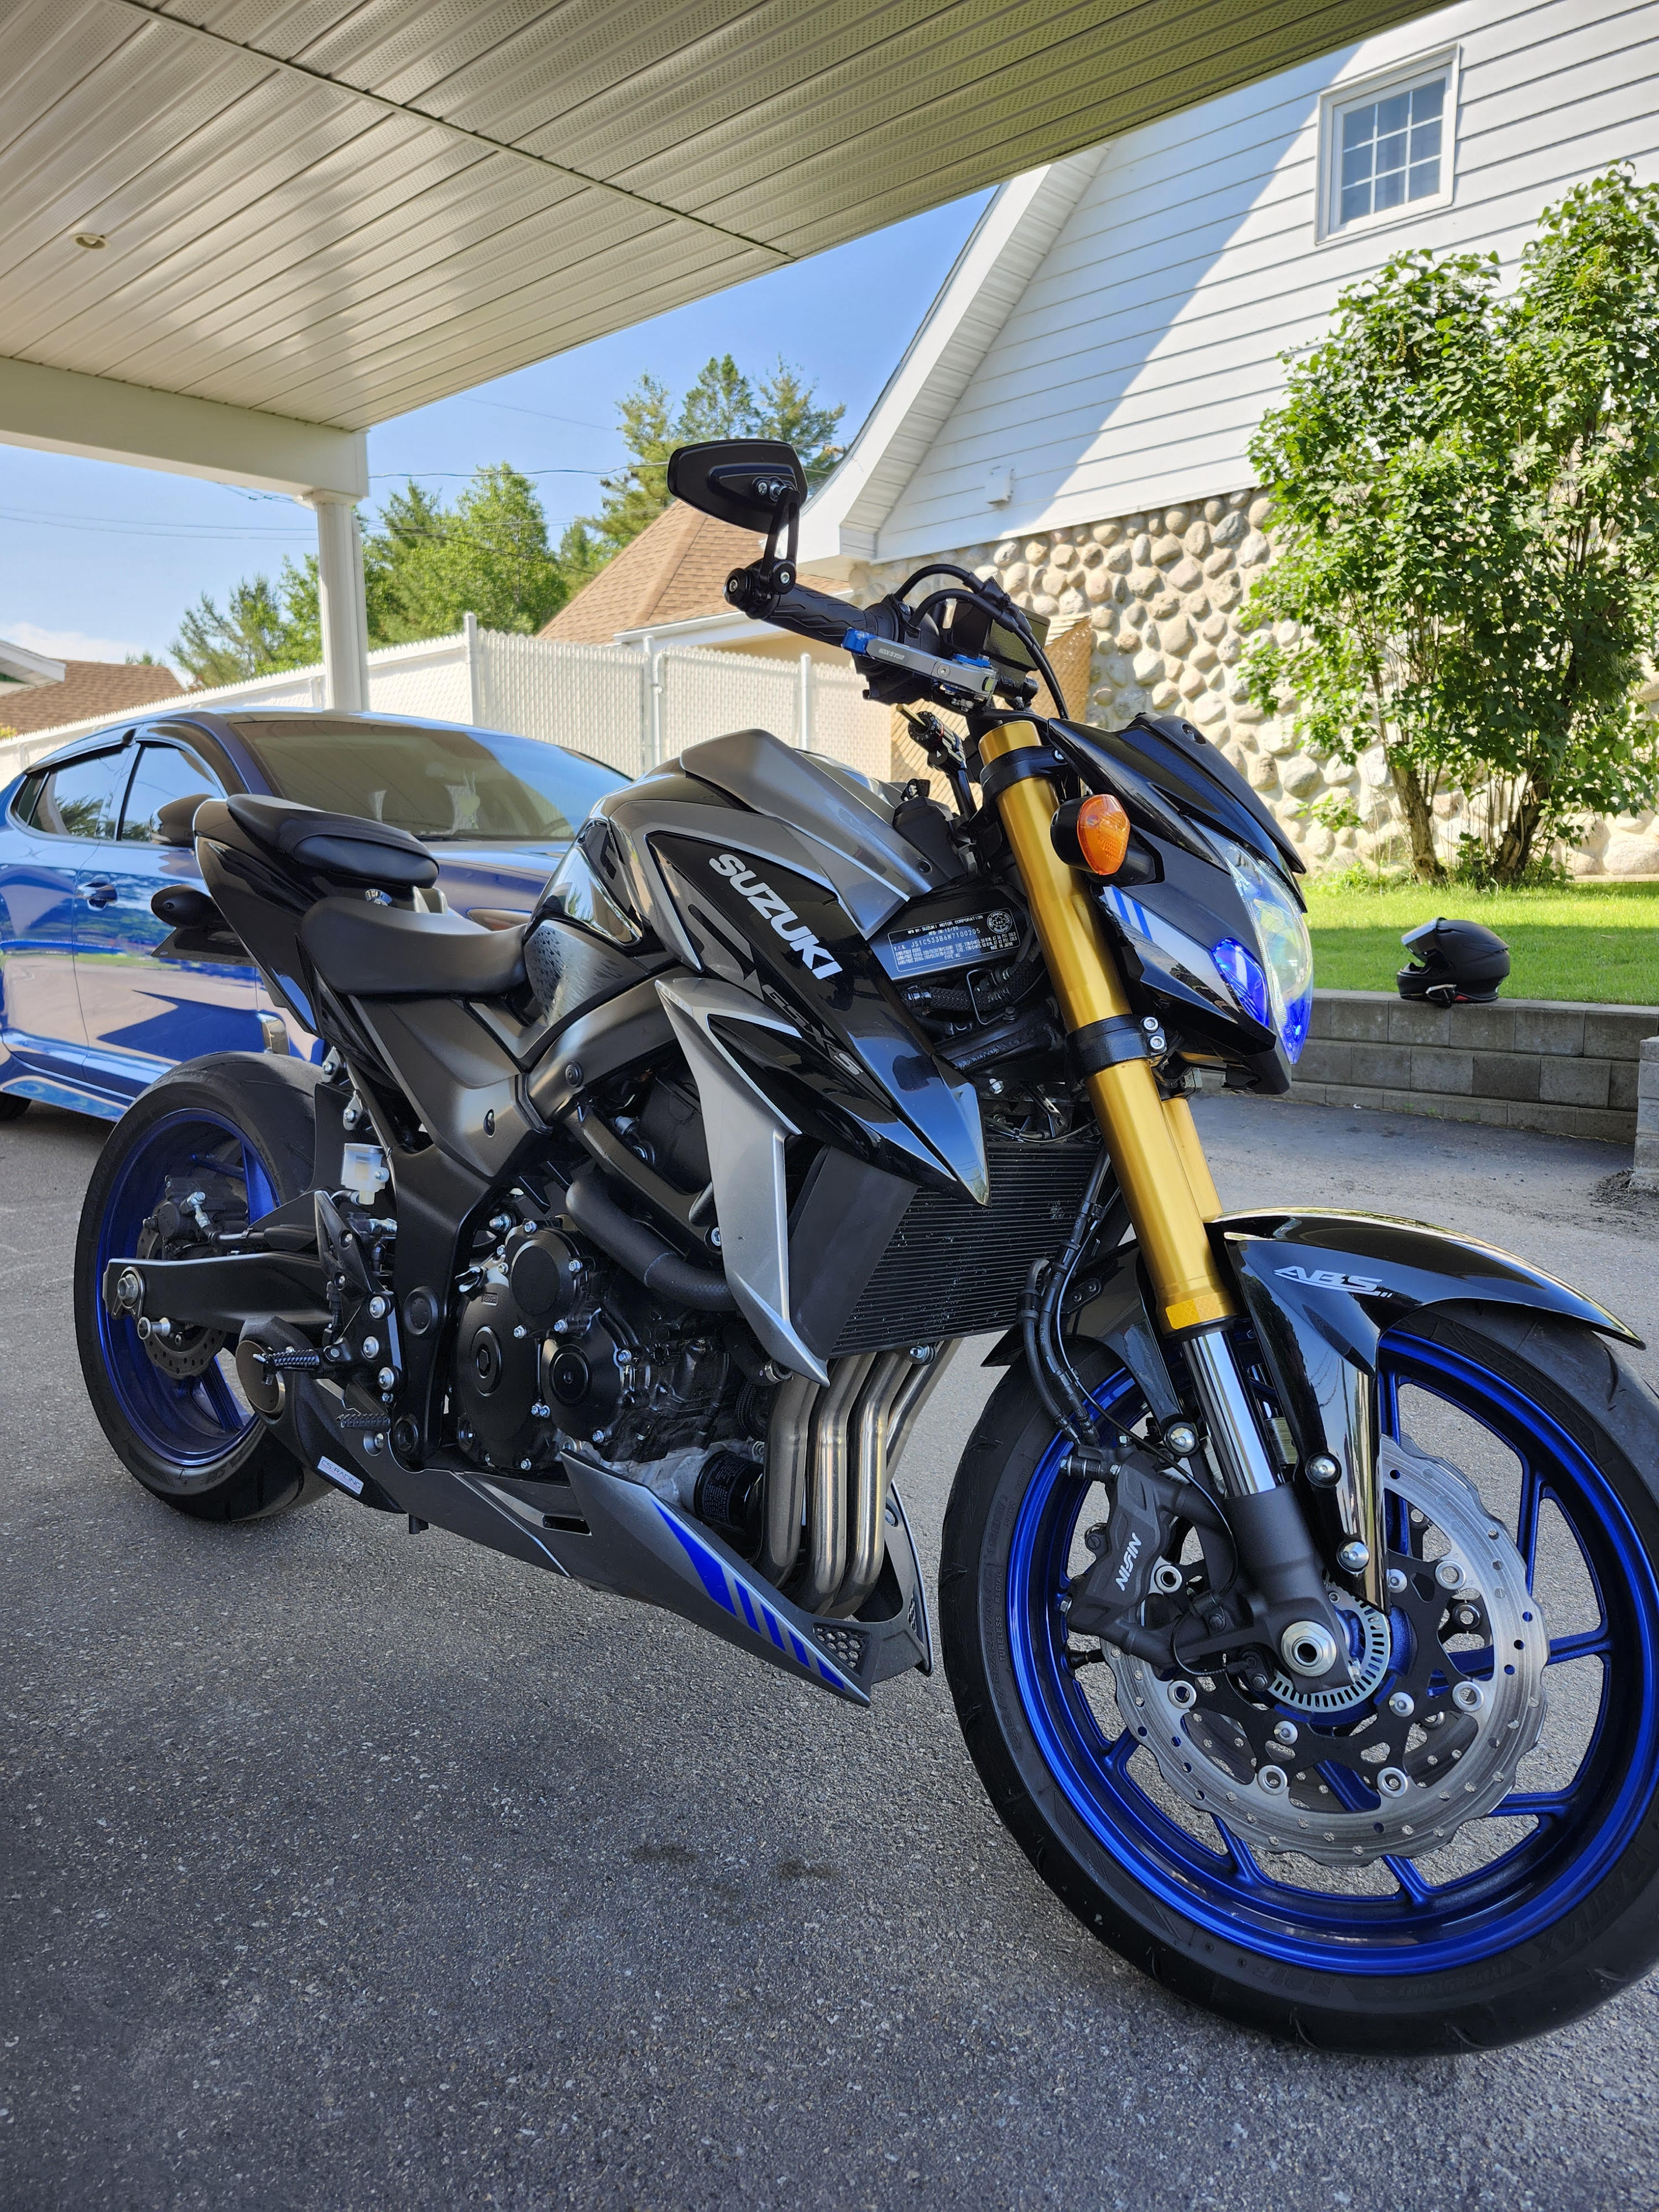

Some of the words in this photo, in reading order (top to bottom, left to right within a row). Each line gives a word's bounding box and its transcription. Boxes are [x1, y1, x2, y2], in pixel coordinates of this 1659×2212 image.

[709, 854, 843, 980] SUZUKI
[954, 915, 983, 924] CORPORATION
[1274, 1265, 1383, 1292] ABS
[321, 1459, 332, 1469] CS
[333, 1467, 362, 1489] RACING
[994, 1572, 1003, 1603] RADIAL
[995, 1615, 1007, 1662] TUBELESS
